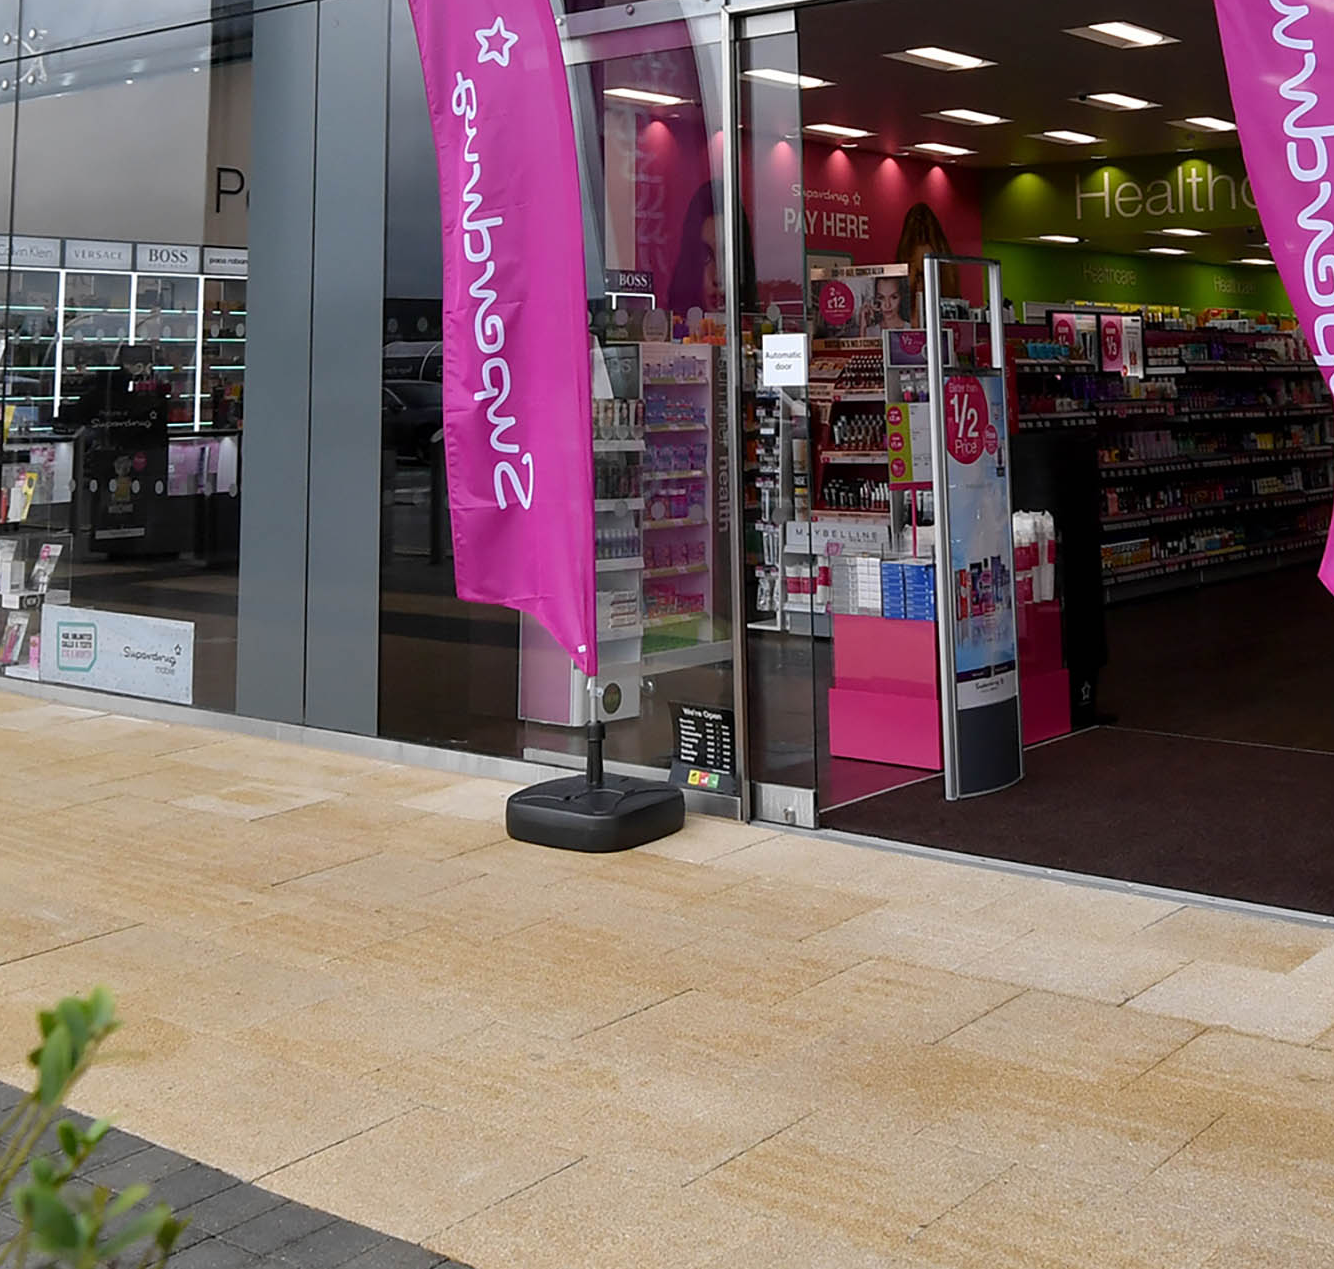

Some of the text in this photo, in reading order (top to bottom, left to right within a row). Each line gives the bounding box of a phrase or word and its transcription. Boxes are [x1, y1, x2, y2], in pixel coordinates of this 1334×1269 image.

[216, 166, 249, 213] P
[784, 207, 869, 239] PAY HERE
[74, 249, 124, 260] VERSACE
[148, 248, 189, 263] BOSS
[619, 273, 648, 286] BOSS
[451, 70, 534, 510] Superdrug
[765, 351, 802, 359] Automatic
[775, 362, 792, 371] door
[950, 393, 979, 438] 1/2
[954, 439, 978, 455] Price
[795, 528, 878, 540] MYBELLINE
[122, 645, 177, 667] Superdrug
[682, 707, 723, 721] We're Open
